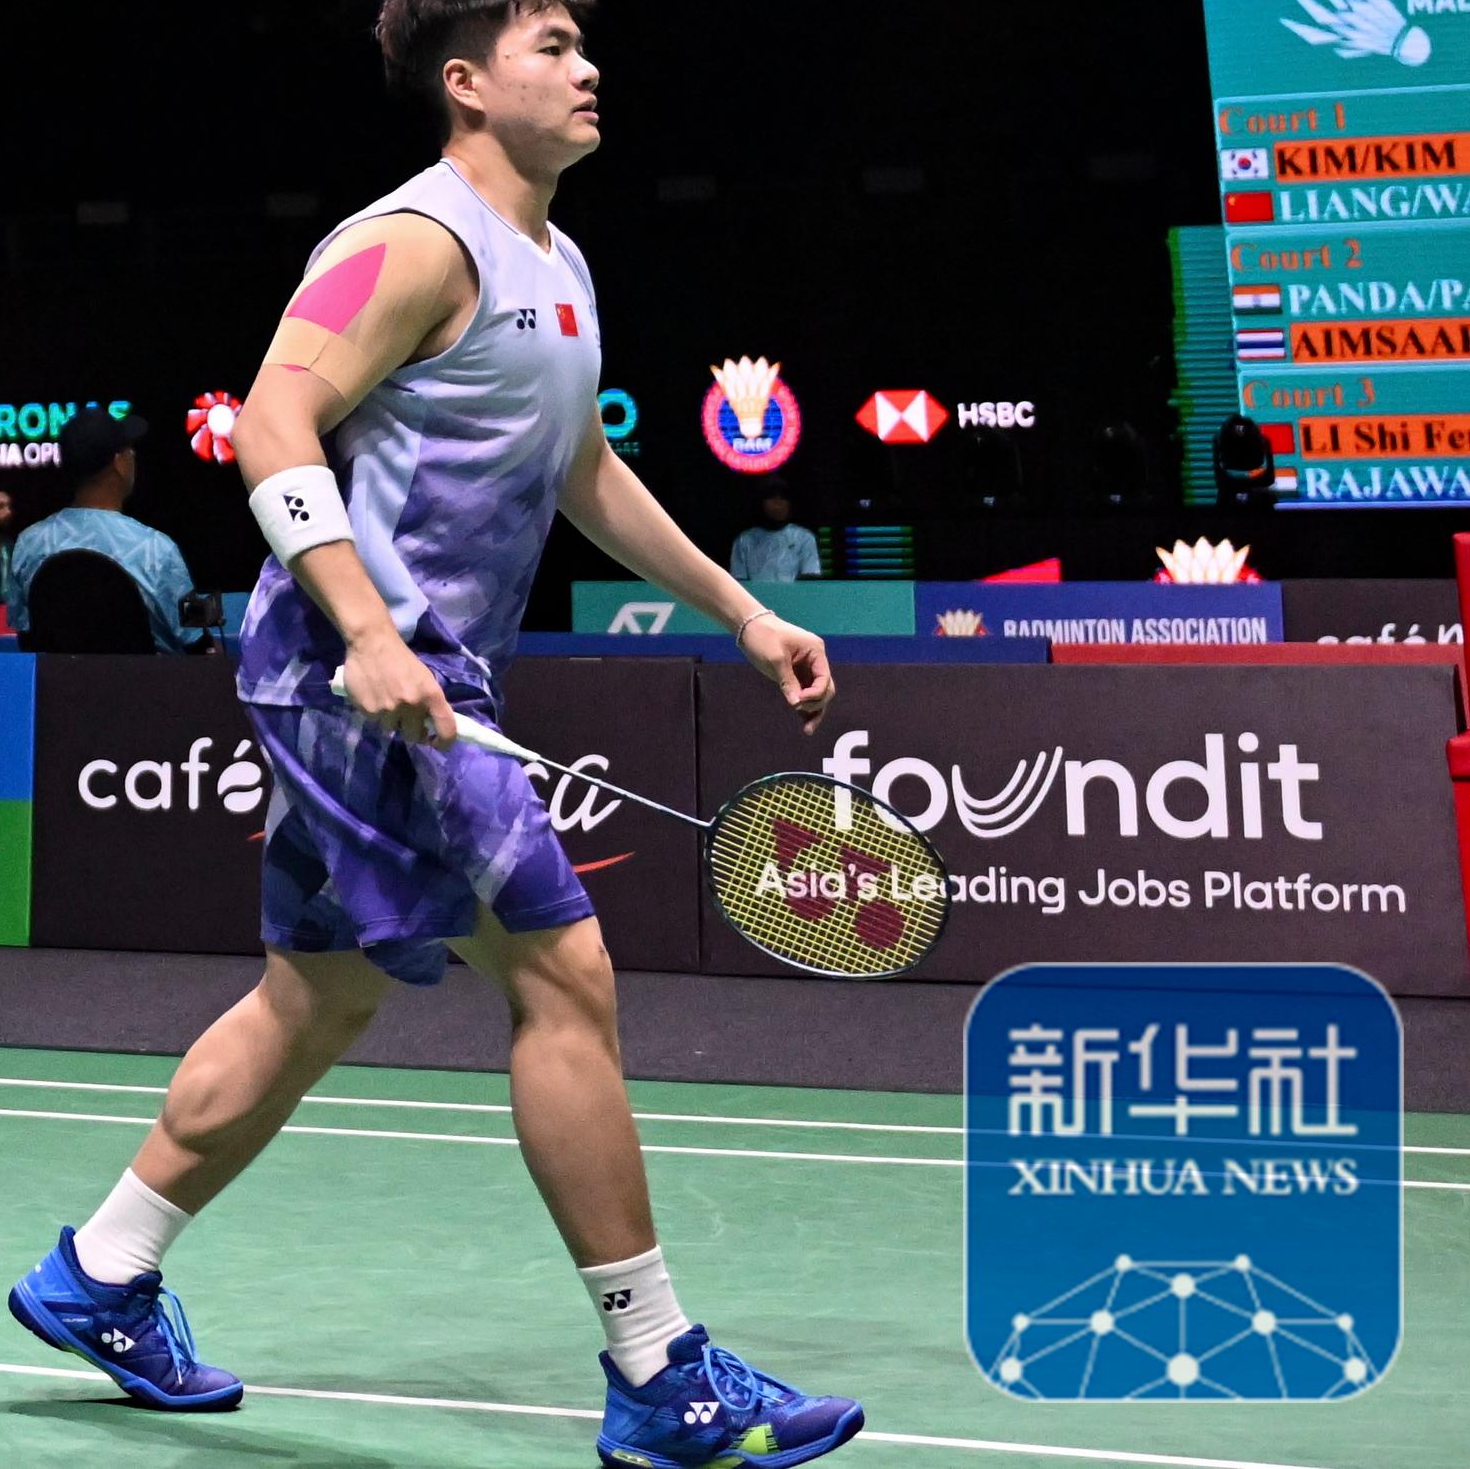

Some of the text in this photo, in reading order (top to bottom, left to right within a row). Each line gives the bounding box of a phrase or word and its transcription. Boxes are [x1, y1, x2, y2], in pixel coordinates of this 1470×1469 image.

[1218, 106, 1318, 135] Court
[1275, 139, 1457, 177] KIM/KIM
[1230, 237, 1363, 272] Court 2
[1242, 376, 1377, 408] Court 3
[958, 400, 1037, 428] HSBC
[1302, 423, 1343, 453] LI
[1354, 420, 1412, 452] Shi
[1003, 616, 1268, 646] BADMINTON ASSOCIATION
[77, 737, 263, 813] café
[822, 730, 1323, 840] foundit
[889, 863, 1065, 914] Leading
[1077, 868, 1191, 909] Jobs
[1205, 870, 1407, 913] Platform
